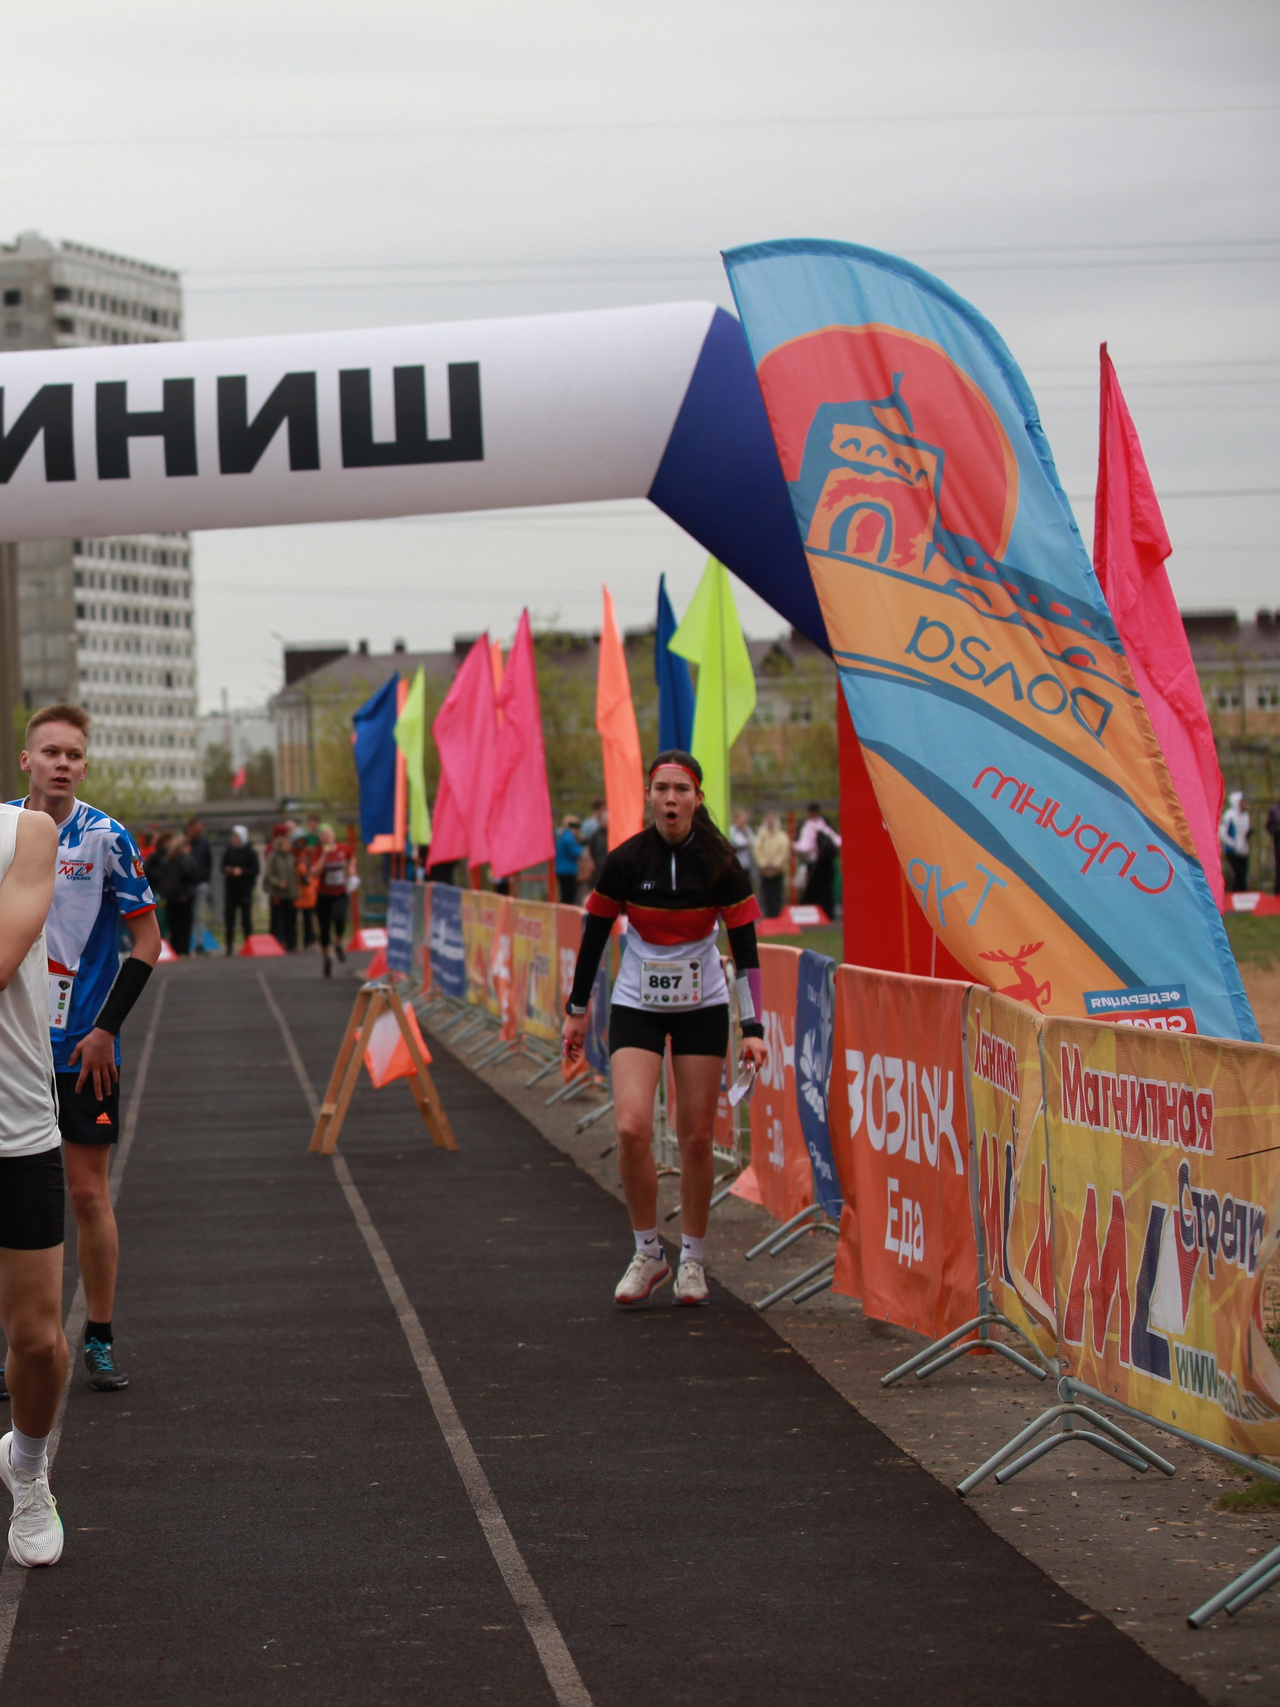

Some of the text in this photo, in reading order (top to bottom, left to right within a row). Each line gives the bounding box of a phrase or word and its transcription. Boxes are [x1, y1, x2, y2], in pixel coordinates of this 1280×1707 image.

[649, 975, 683, 989] 867
[1060, 1042, 1214, 1156] Магнитная
[884, 1175, 925, 1268] Еда
